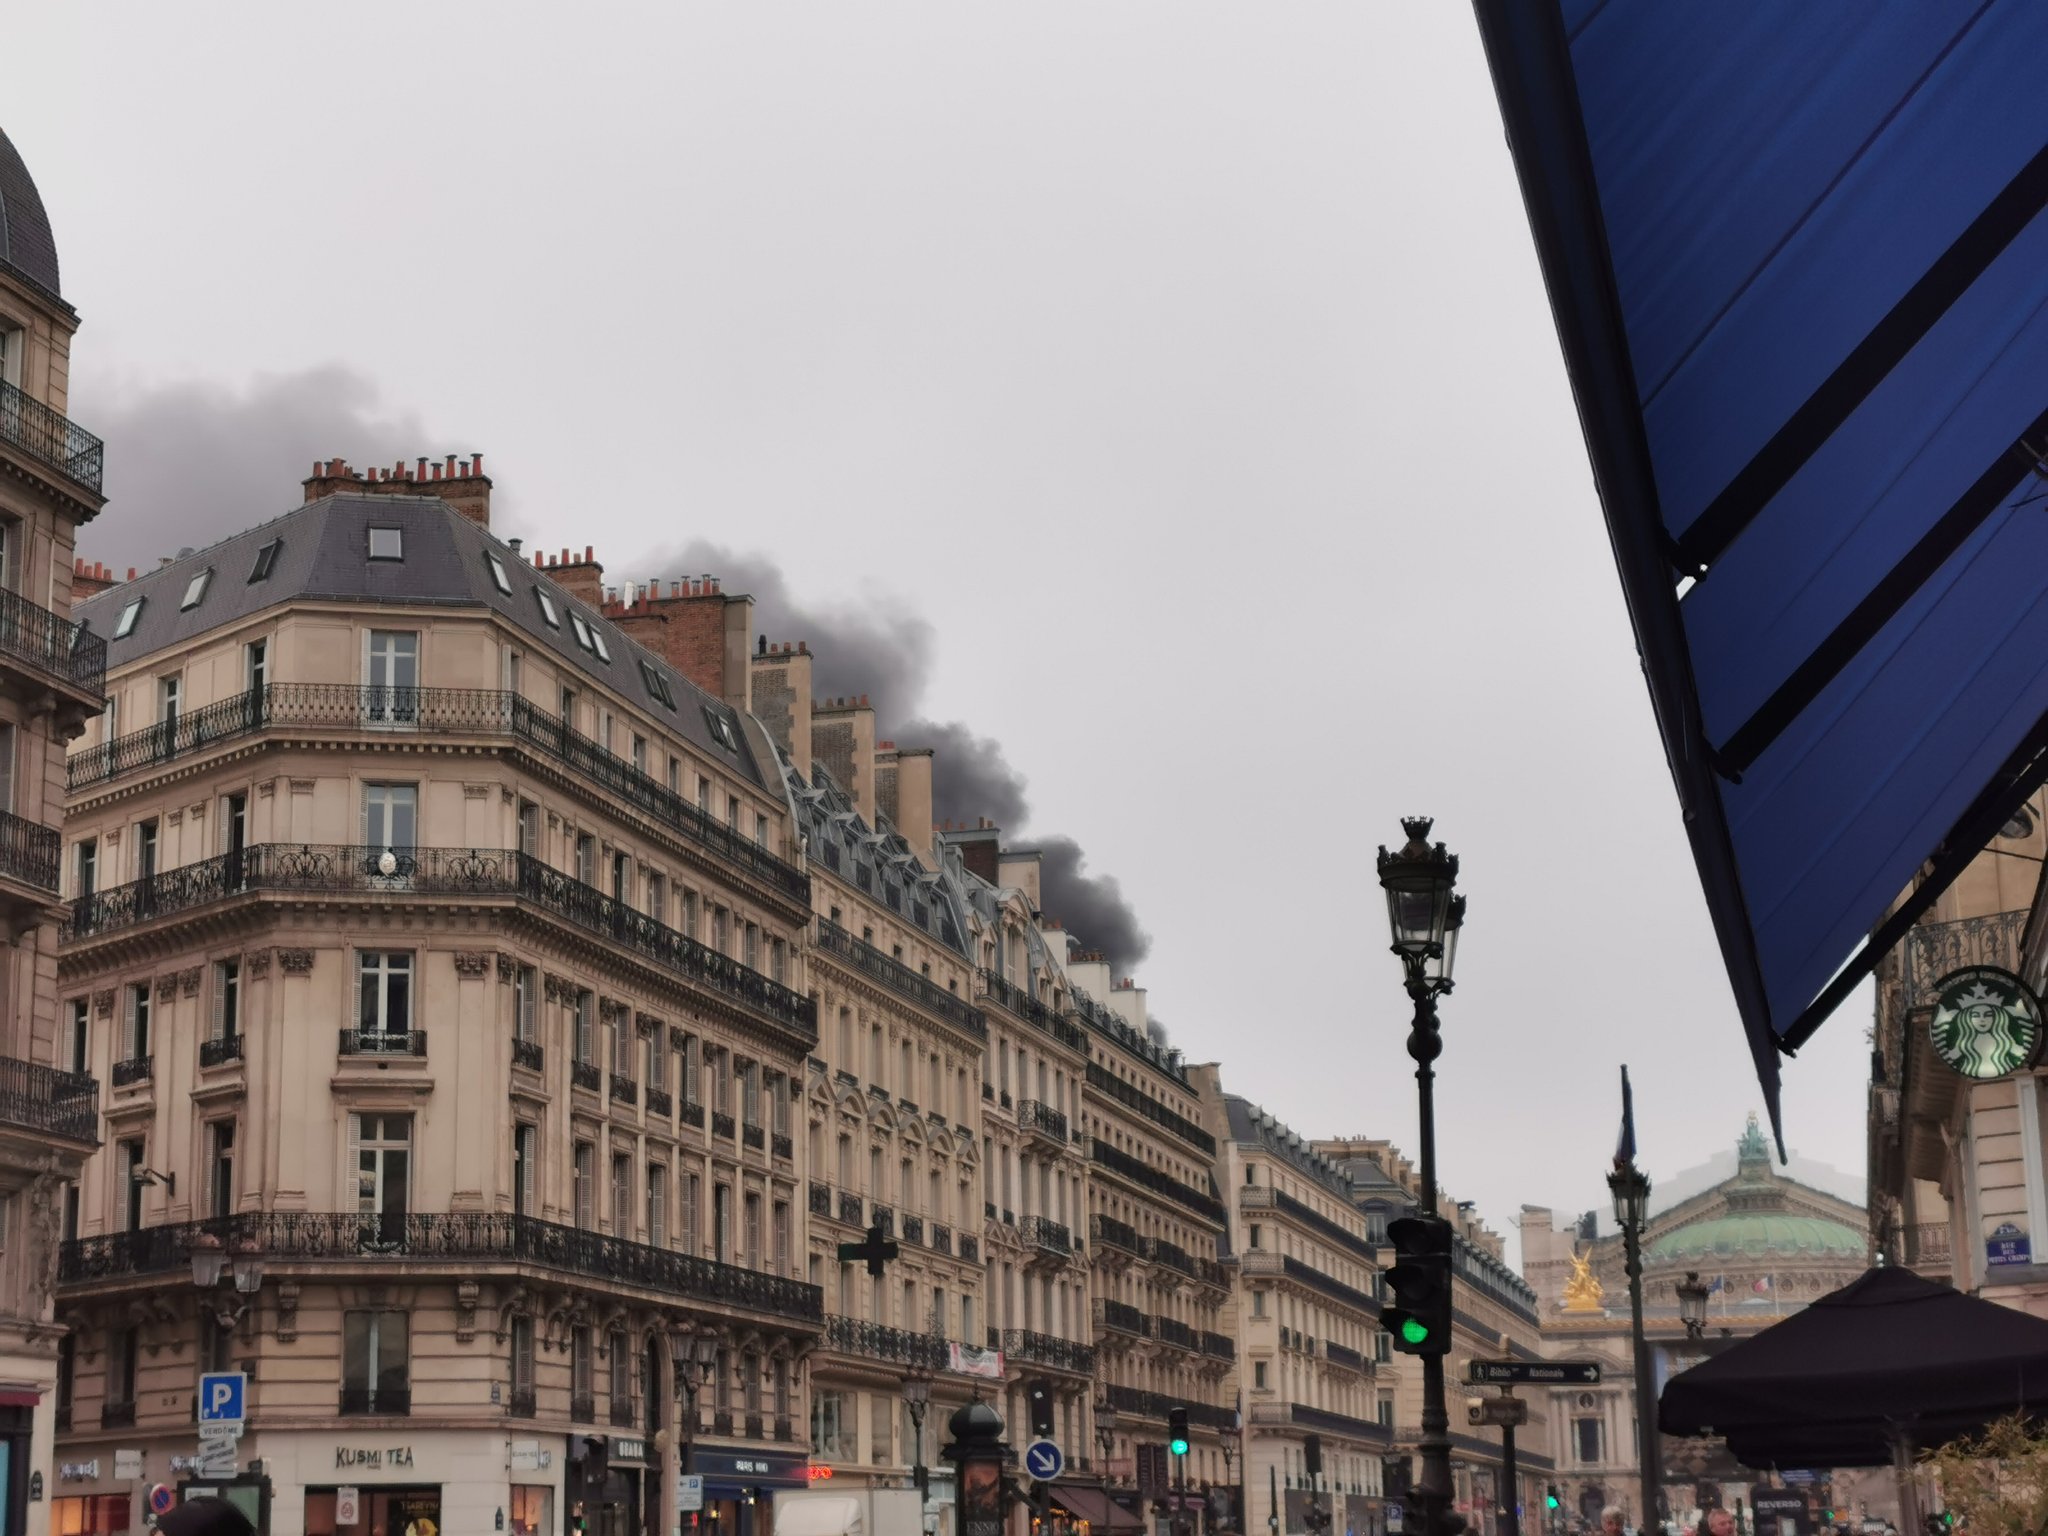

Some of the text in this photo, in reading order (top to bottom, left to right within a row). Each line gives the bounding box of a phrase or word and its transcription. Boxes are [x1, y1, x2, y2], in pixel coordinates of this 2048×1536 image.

[1528, 1367, 1565, 1378] Nationale
[212, 1383, 232, 1413] P
[336, 1446, 414, 1469] KUSMI TEA
[1757, 1500, 1803, 1509] REVERSO
